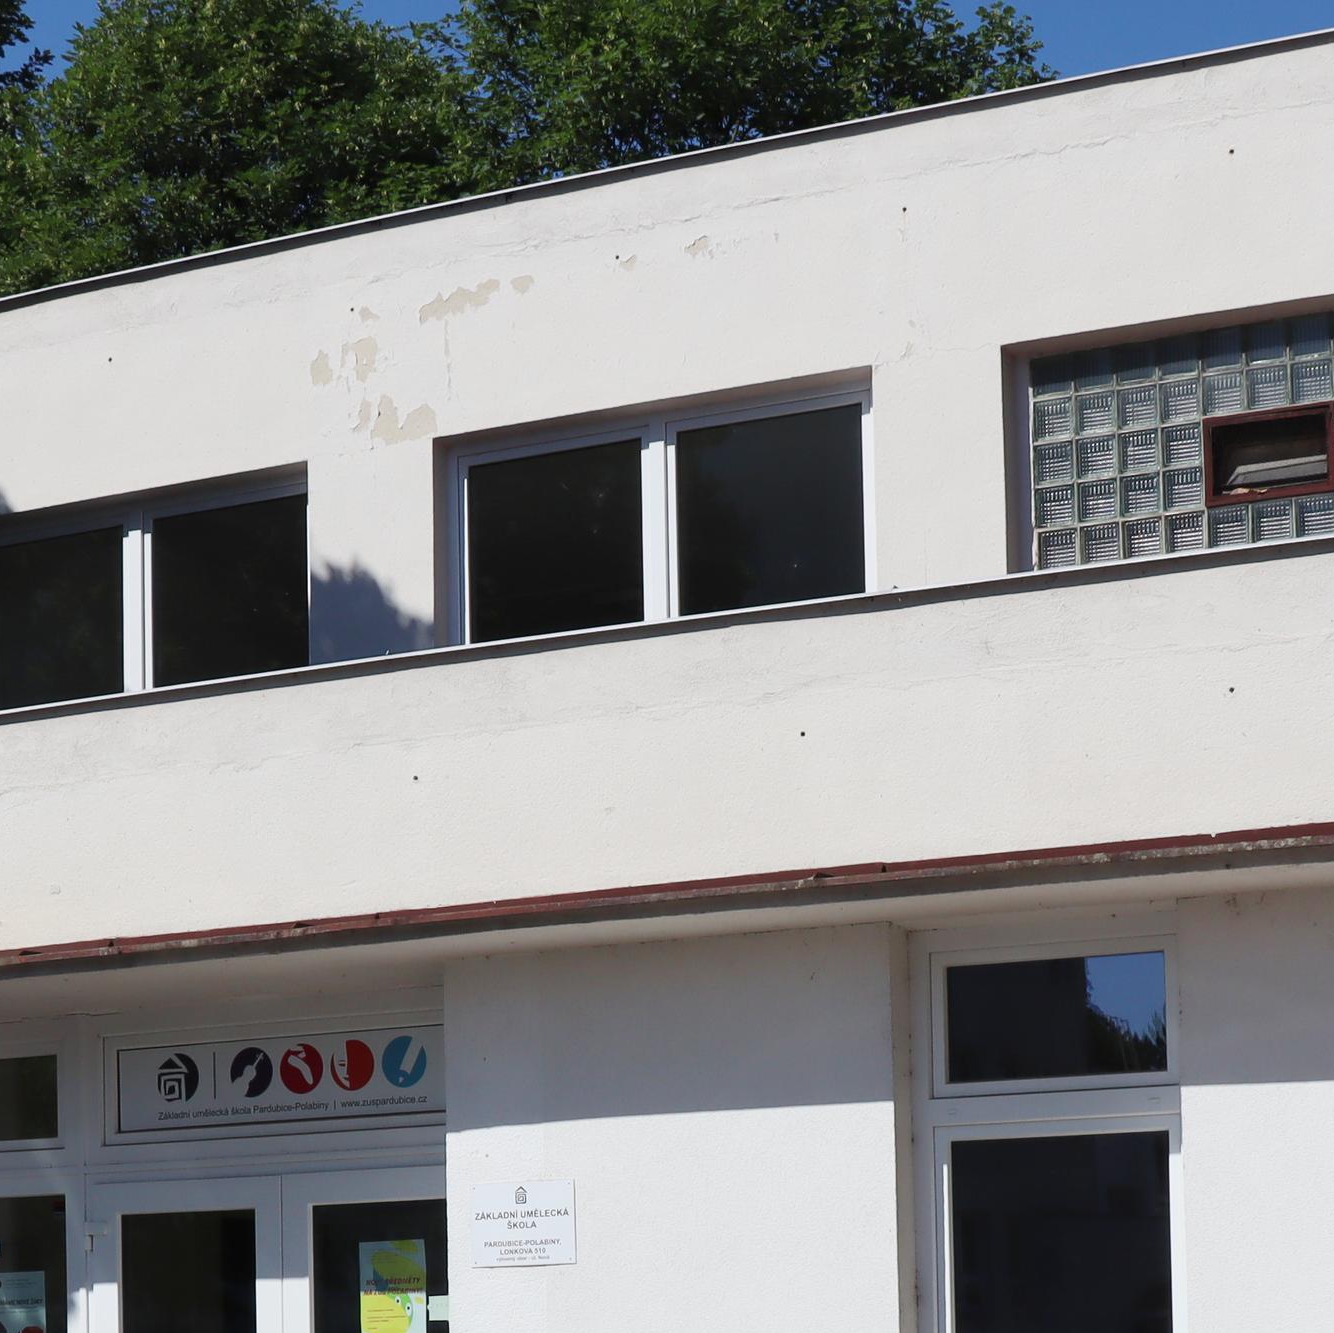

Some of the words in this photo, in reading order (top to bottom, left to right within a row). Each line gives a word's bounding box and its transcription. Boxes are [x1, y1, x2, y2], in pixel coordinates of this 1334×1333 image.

[158, 1110, 191, 1121] Základní
[192, 1106, 229, 1118] umělecká
[231, 1105, 252, 1115] škola
[253, 1101, 329, 1114] Pardubice-Polabiny
[339, 1095, 428, 1109] www.zuspardubice.cz
[475, 1210, 518, 1221] ZÁKLADNÍ
[520, 1207, 570, 1219] UMĚLECKÁ
[507, 1221, 537, 1230] ŠKOLA
[500, 1248, 533, 1256] LONKOVA
